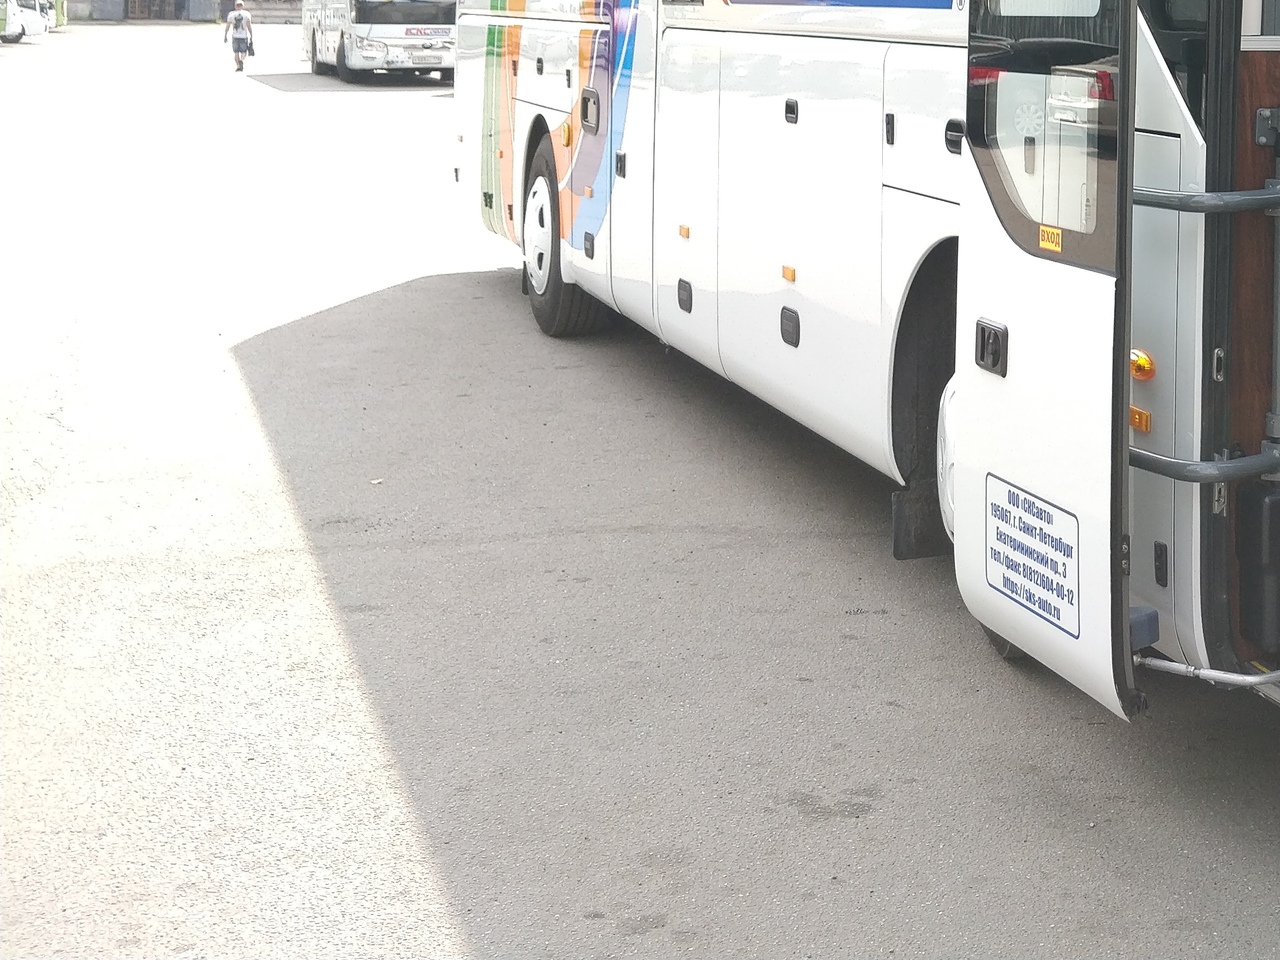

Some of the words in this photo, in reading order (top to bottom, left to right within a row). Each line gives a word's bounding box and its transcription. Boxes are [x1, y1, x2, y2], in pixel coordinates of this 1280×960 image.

[1040, 229, 1061, 248] ВХОД
[1008, 489, 1020, 509] ООО
[996, 526, 1049, 569] Екатерининский
[1062, 562, 1067, 579] 3
[1018, 516, 1074, 559] Санкт-Петербург
